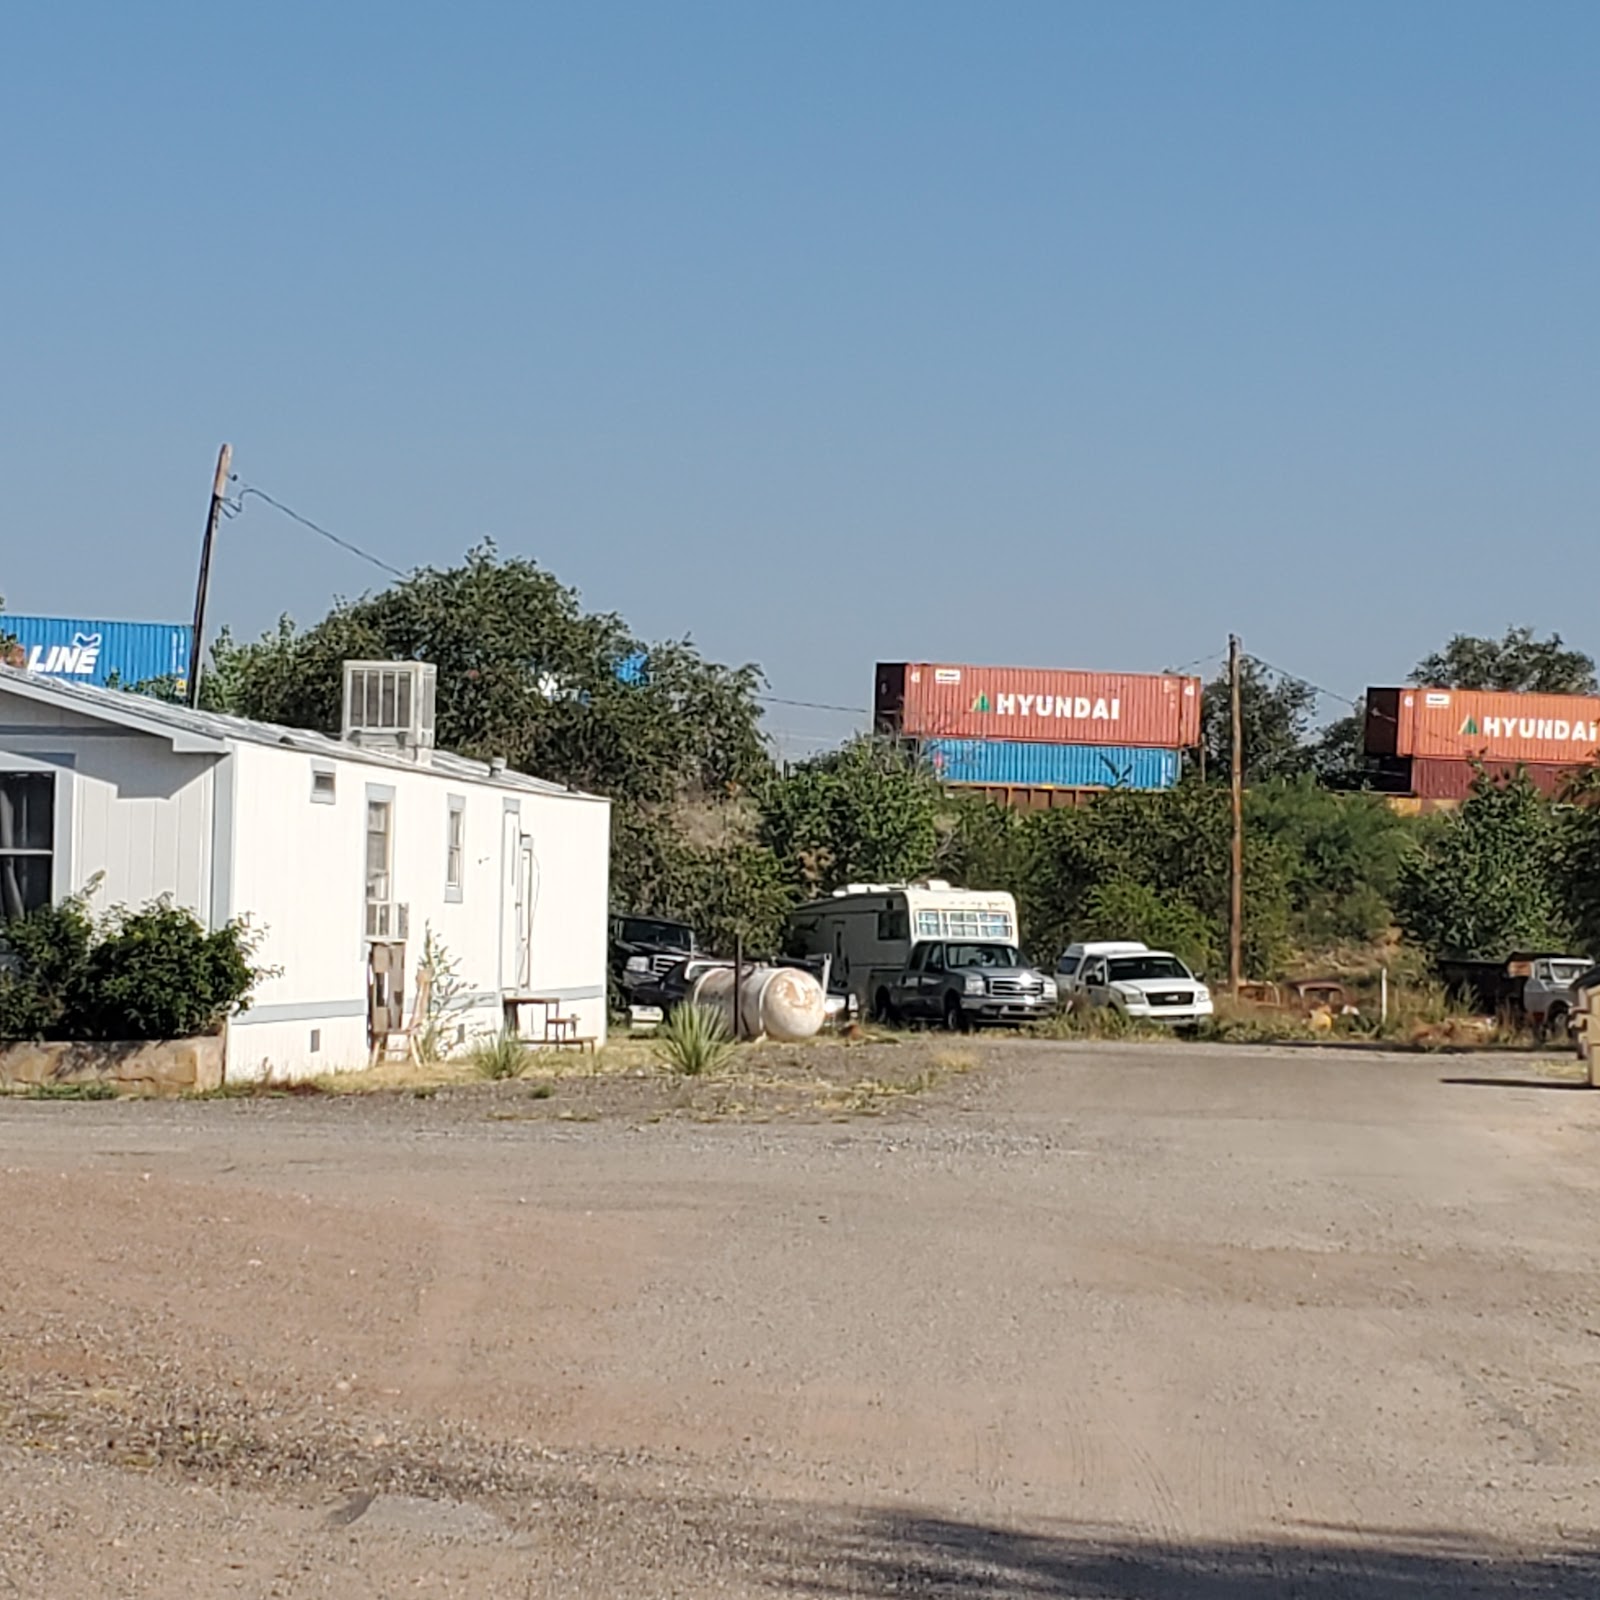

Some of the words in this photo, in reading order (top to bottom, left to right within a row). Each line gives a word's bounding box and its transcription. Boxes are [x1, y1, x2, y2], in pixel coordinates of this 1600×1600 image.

[27, 645, 100, 674] LINE
[997, 692, 1121, 720] HYUNDAI
[1483, 716, 1598, 742] HYUNDAI
